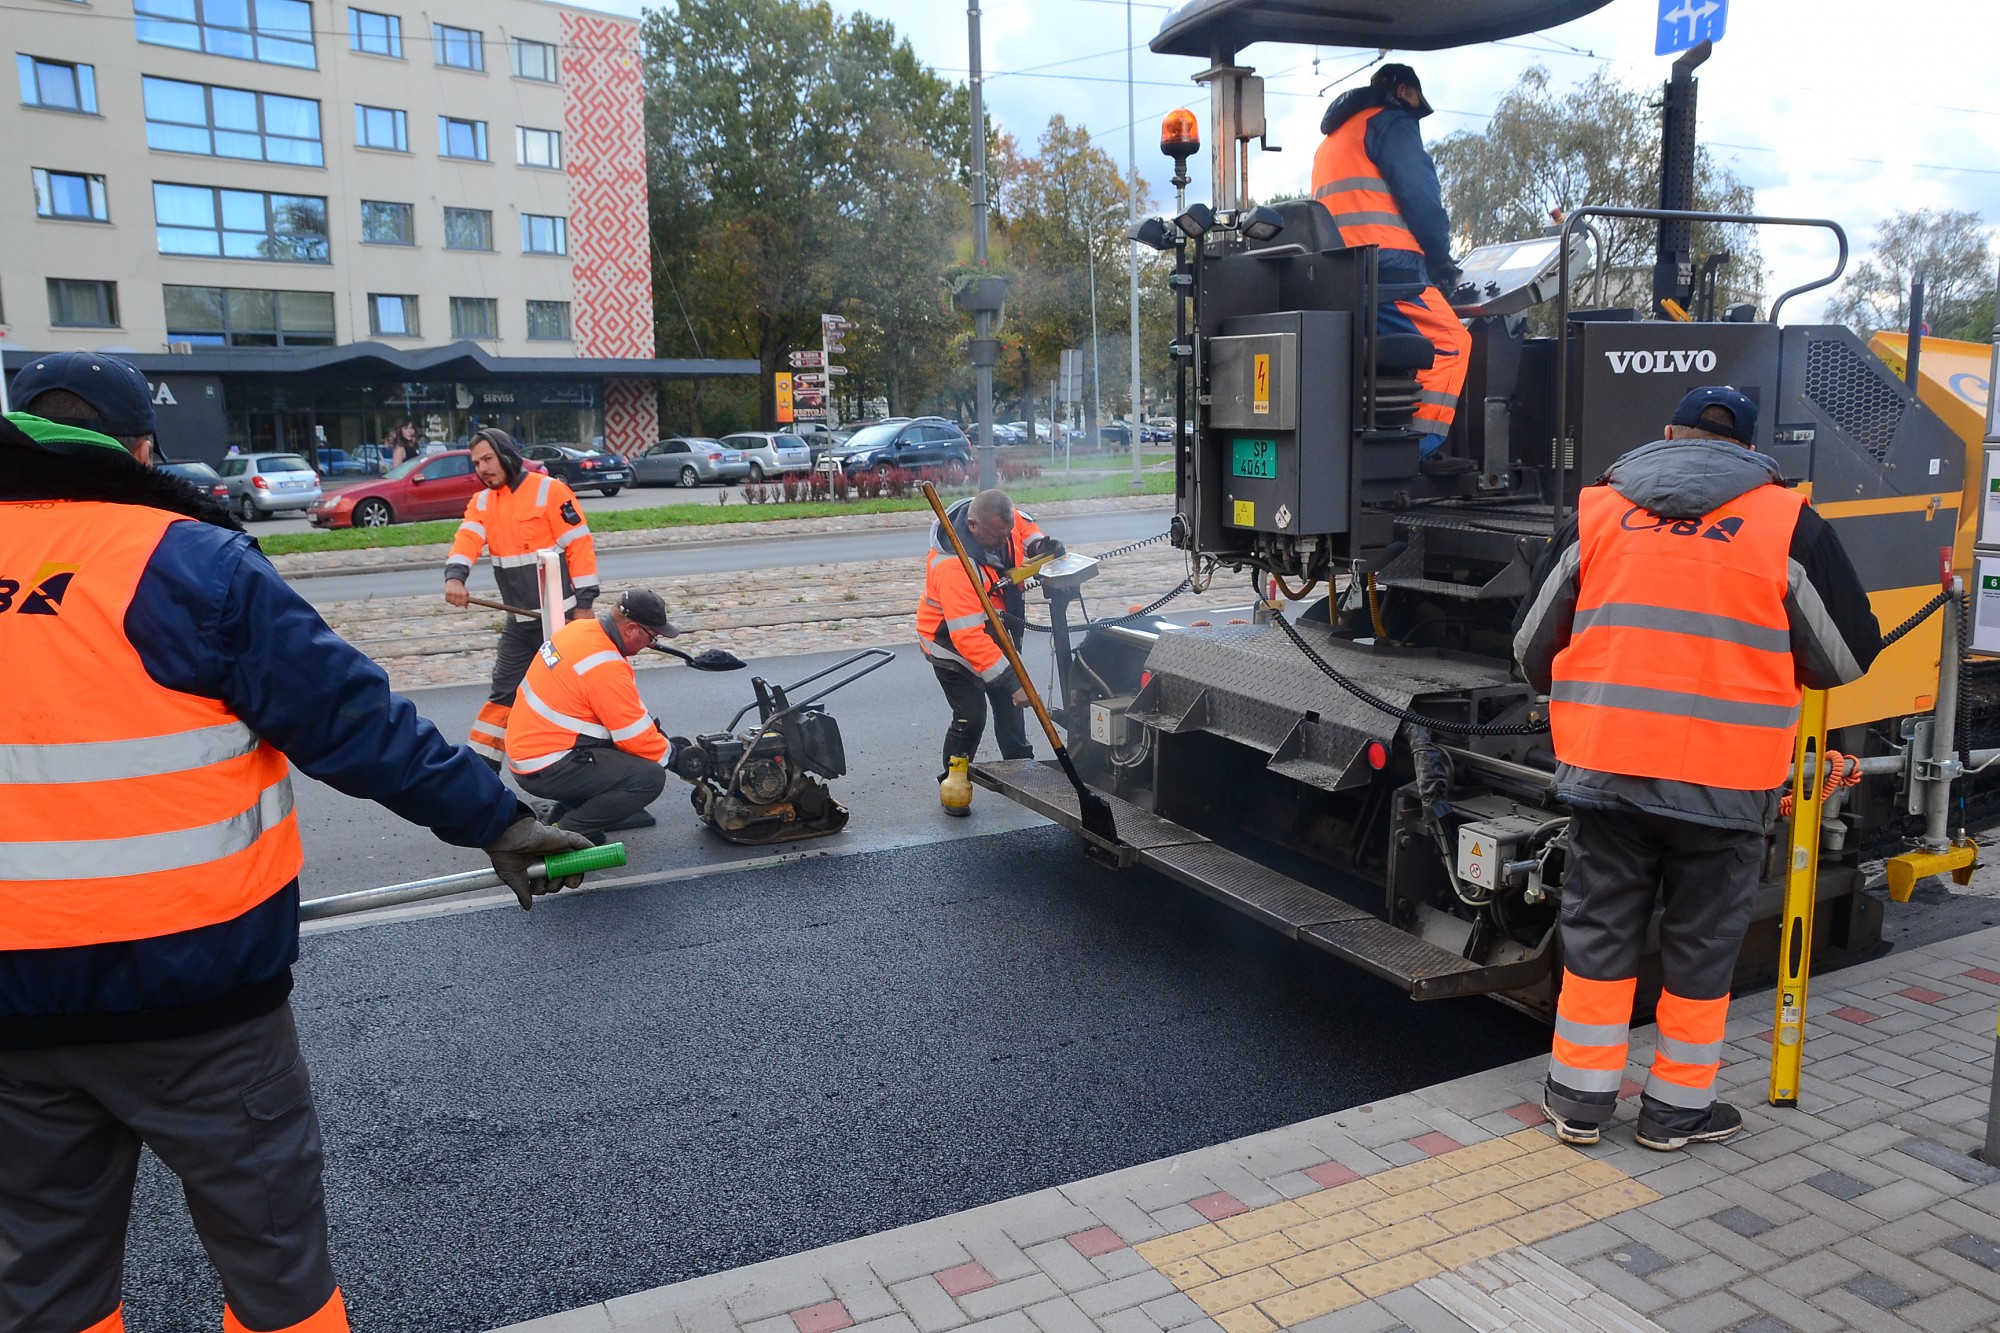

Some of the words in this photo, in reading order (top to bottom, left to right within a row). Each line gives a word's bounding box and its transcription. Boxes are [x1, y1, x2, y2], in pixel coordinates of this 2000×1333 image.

[1604, 349, 1717, 374] VOLVO
[483, 393, 515, 403] SERVISS
[1254, 442, 1267, 457] SP
[1241, 459, 1267, 476] 4061
[1990, 578, 1998, 588] 6
